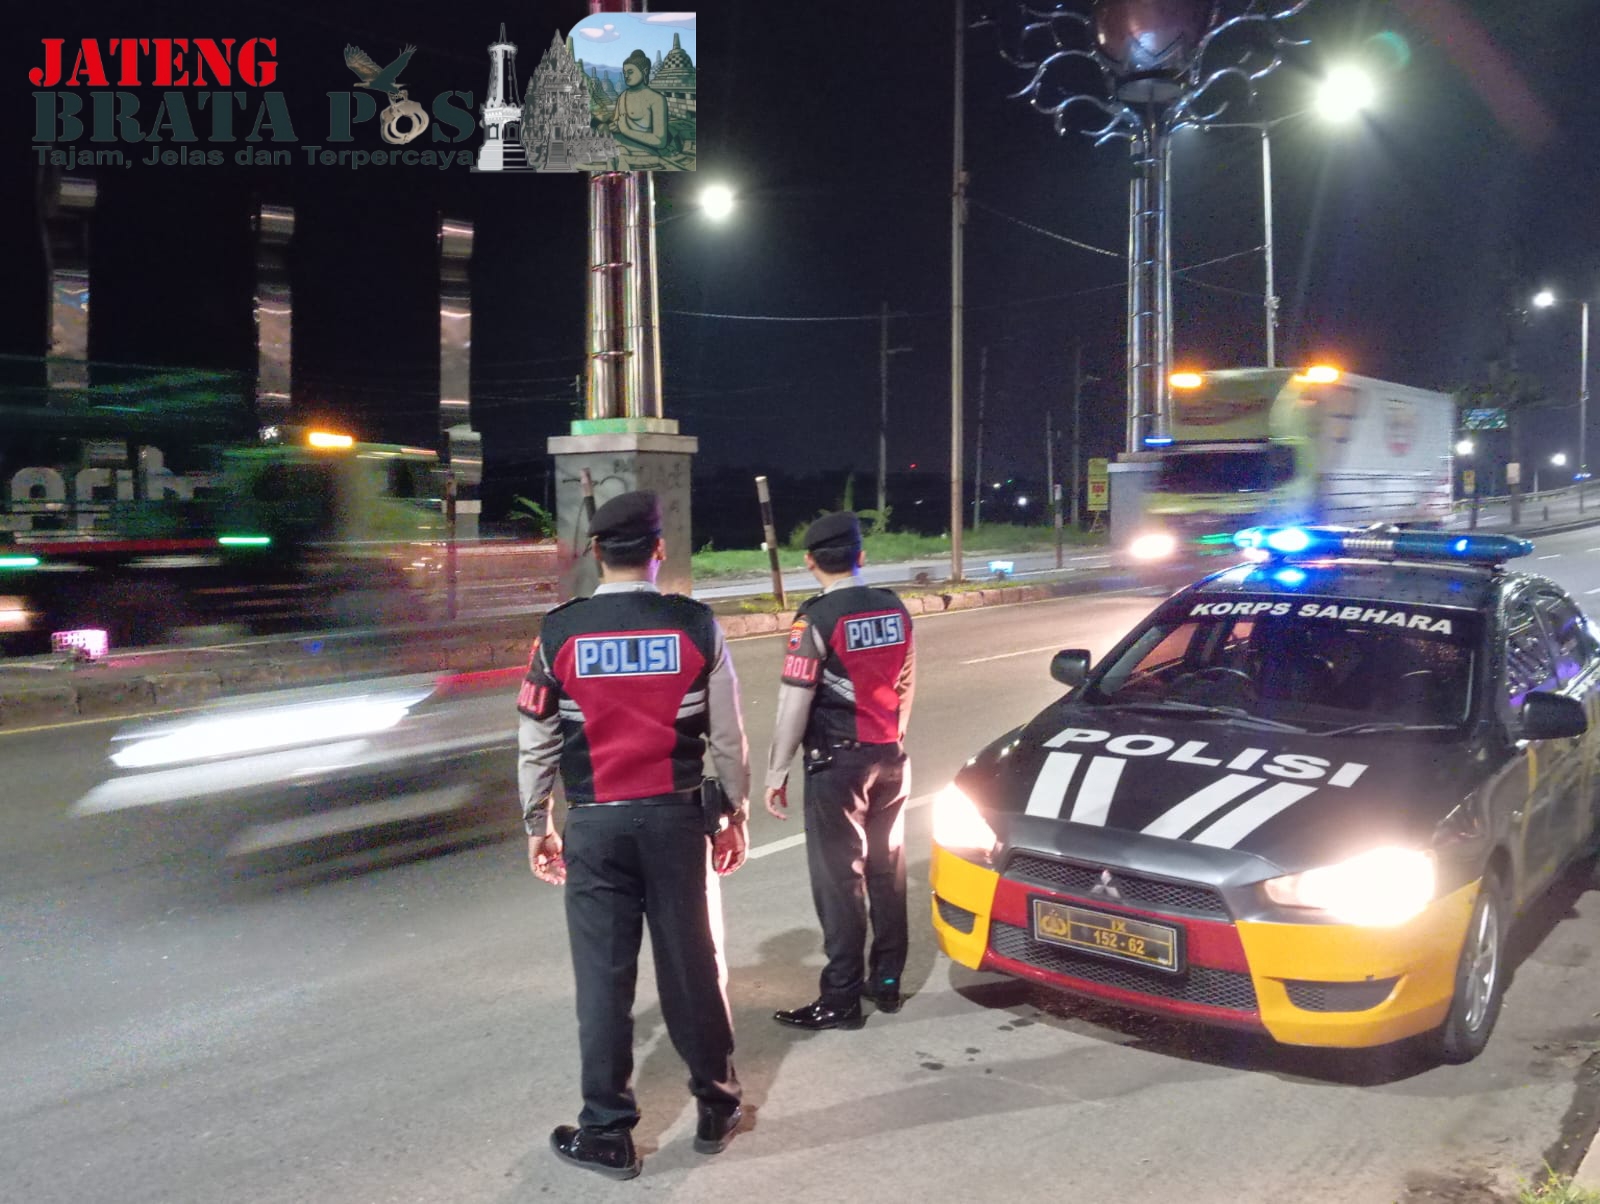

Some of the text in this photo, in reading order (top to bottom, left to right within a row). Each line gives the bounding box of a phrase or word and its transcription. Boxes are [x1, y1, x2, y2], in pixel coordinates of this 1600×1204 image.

[847, 616, 904, 649] POLISI
[1189, 602, 1453, 634] KORPS SABHARA
[580, 637, 677, 674] POLISI
[1042, 727, 1369, 788] POLISI
